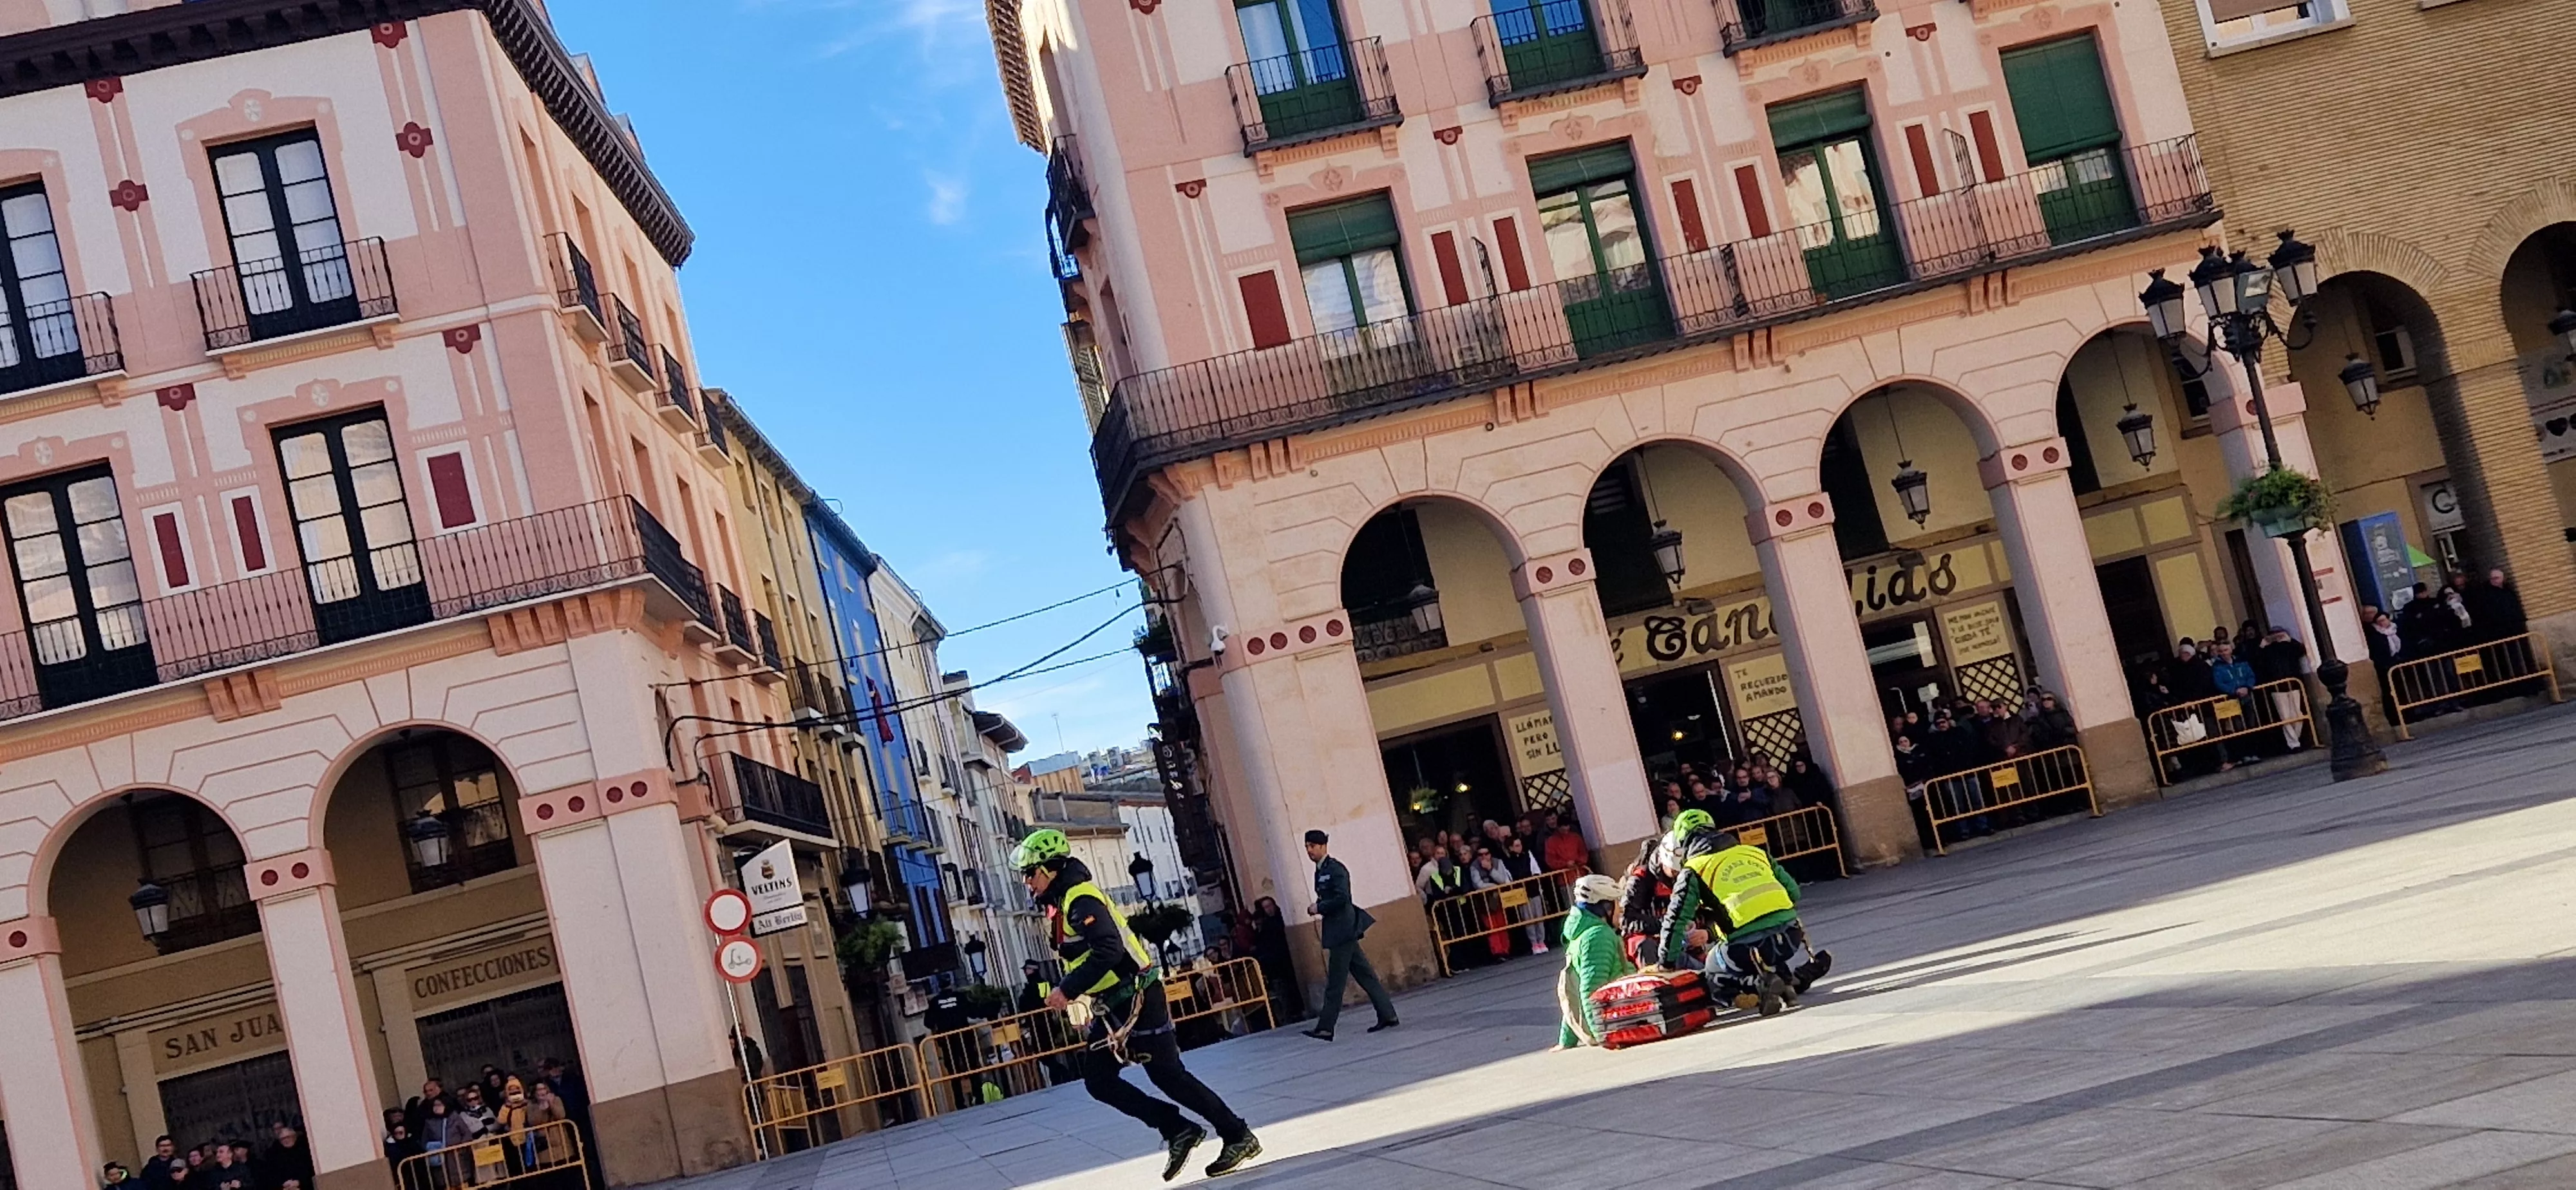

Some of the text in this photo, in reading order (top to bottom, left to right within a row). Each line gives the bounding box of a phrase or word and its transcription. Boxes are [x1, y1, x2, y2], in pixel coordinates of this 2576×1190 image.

[1523, 732, 1548, 746] PERO
[1526, 748, 1542, 760] SIN
[750, 876, 793, 896] VELTINS
[758, 919, 773, 930] Alt
[414, 947, 551, 999] CONFECCIONES
[165, 1027, 219, 1059] SAN
